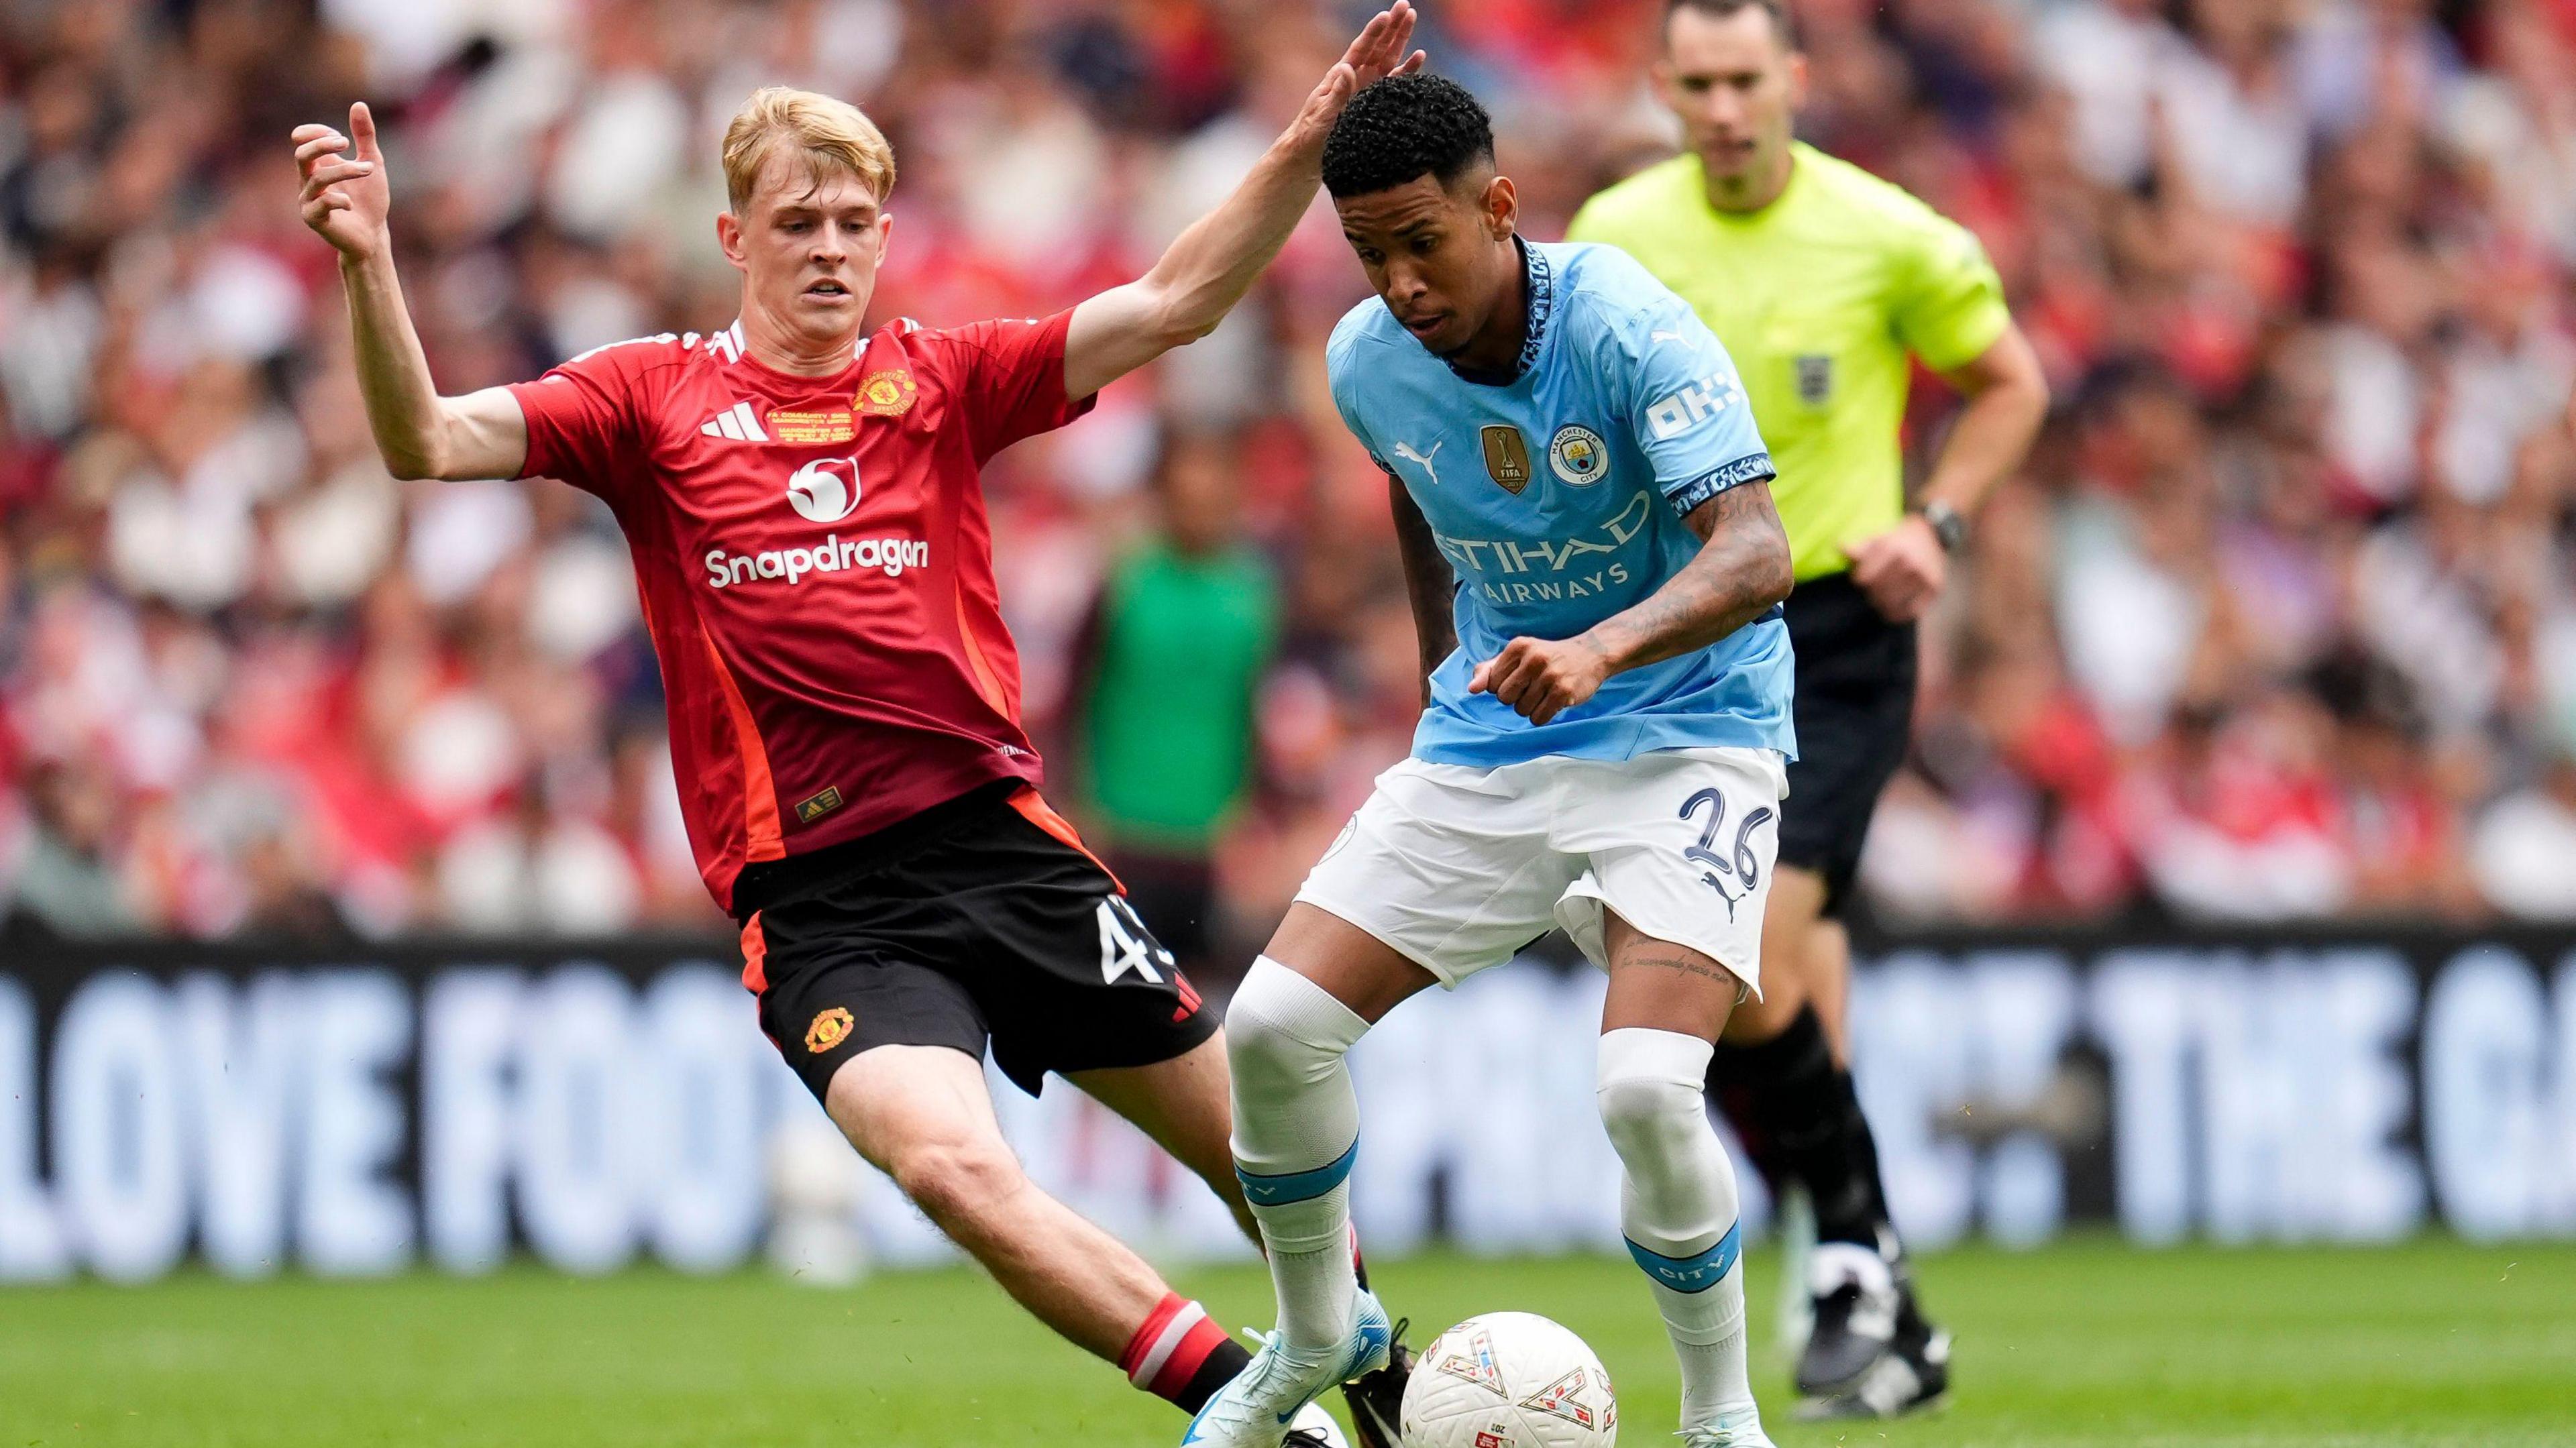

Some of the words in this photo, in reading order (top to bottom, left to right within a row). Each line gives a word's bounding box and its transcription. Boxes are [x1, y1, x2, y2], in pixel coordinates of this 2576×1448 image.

[1552, 428, 1598, 454] MANCHESTER
[1500, 469, 1521, 478] FIFA
[1580, 471, 1599, 483] CITY
[705, 534, 928, 588] Snapdragon
[1484, 563, 1629, 604] AIRWAYS
[1678, 787, 1773, 891] 26
[1659, 1254, 1725, 1282] CITY
